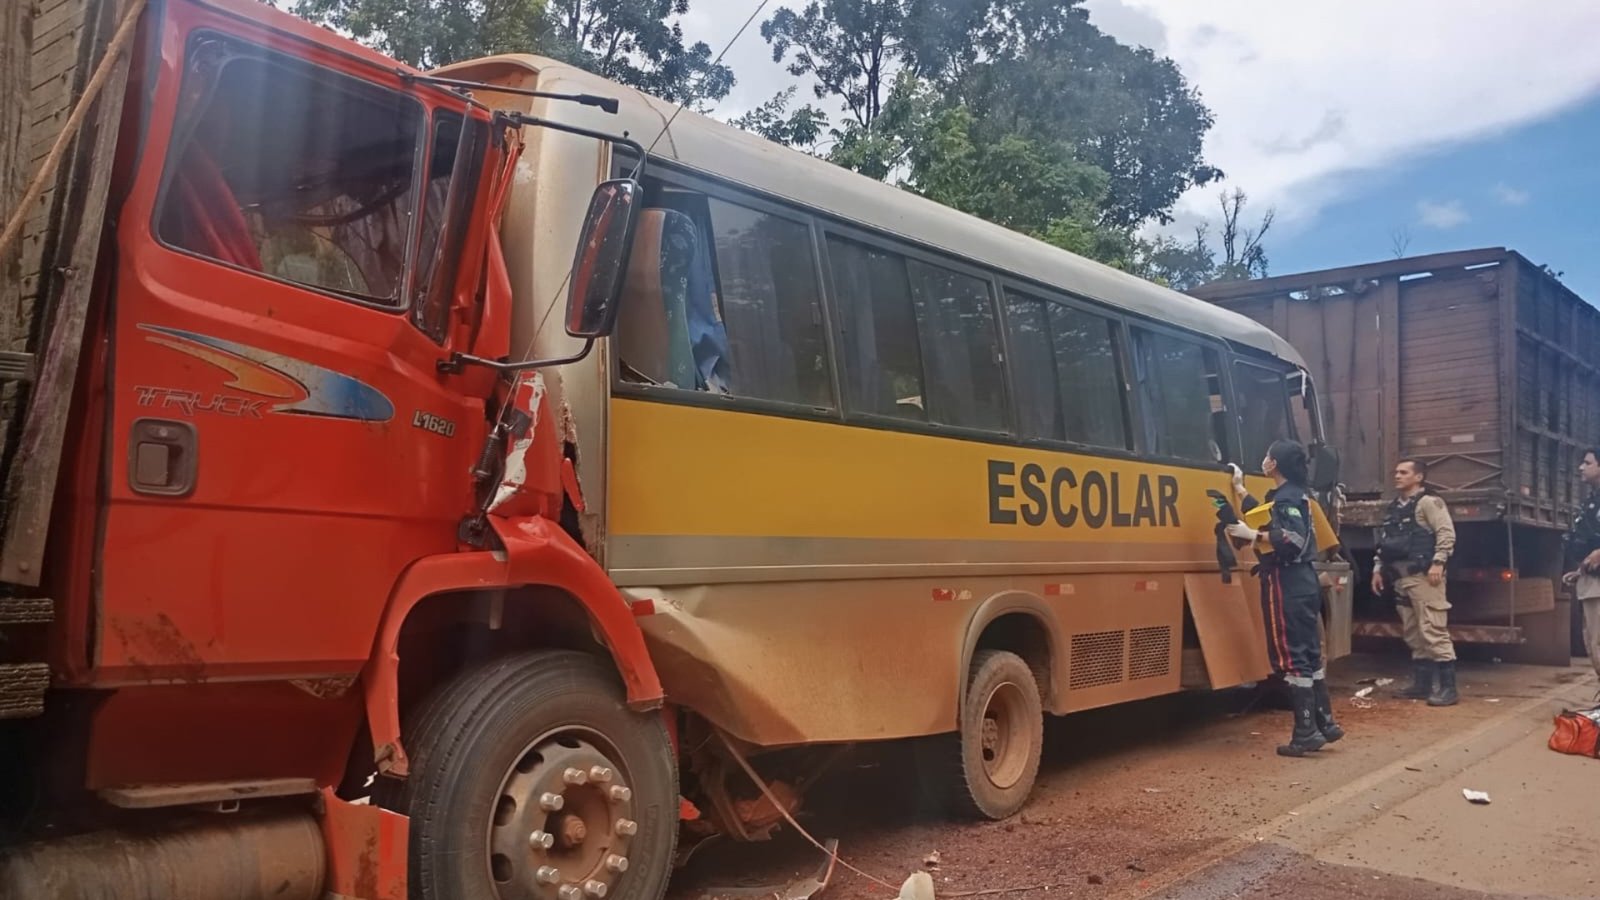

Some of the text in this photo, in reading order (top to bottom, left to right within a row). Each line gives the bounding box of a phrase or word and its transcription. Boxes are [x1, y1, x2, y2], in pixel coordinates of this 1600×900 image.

[134, 385, 266, 418] TRUCK
[413, 409, 455, 437] L1620
[988, 459, 1180, 529] ESCOLAR
